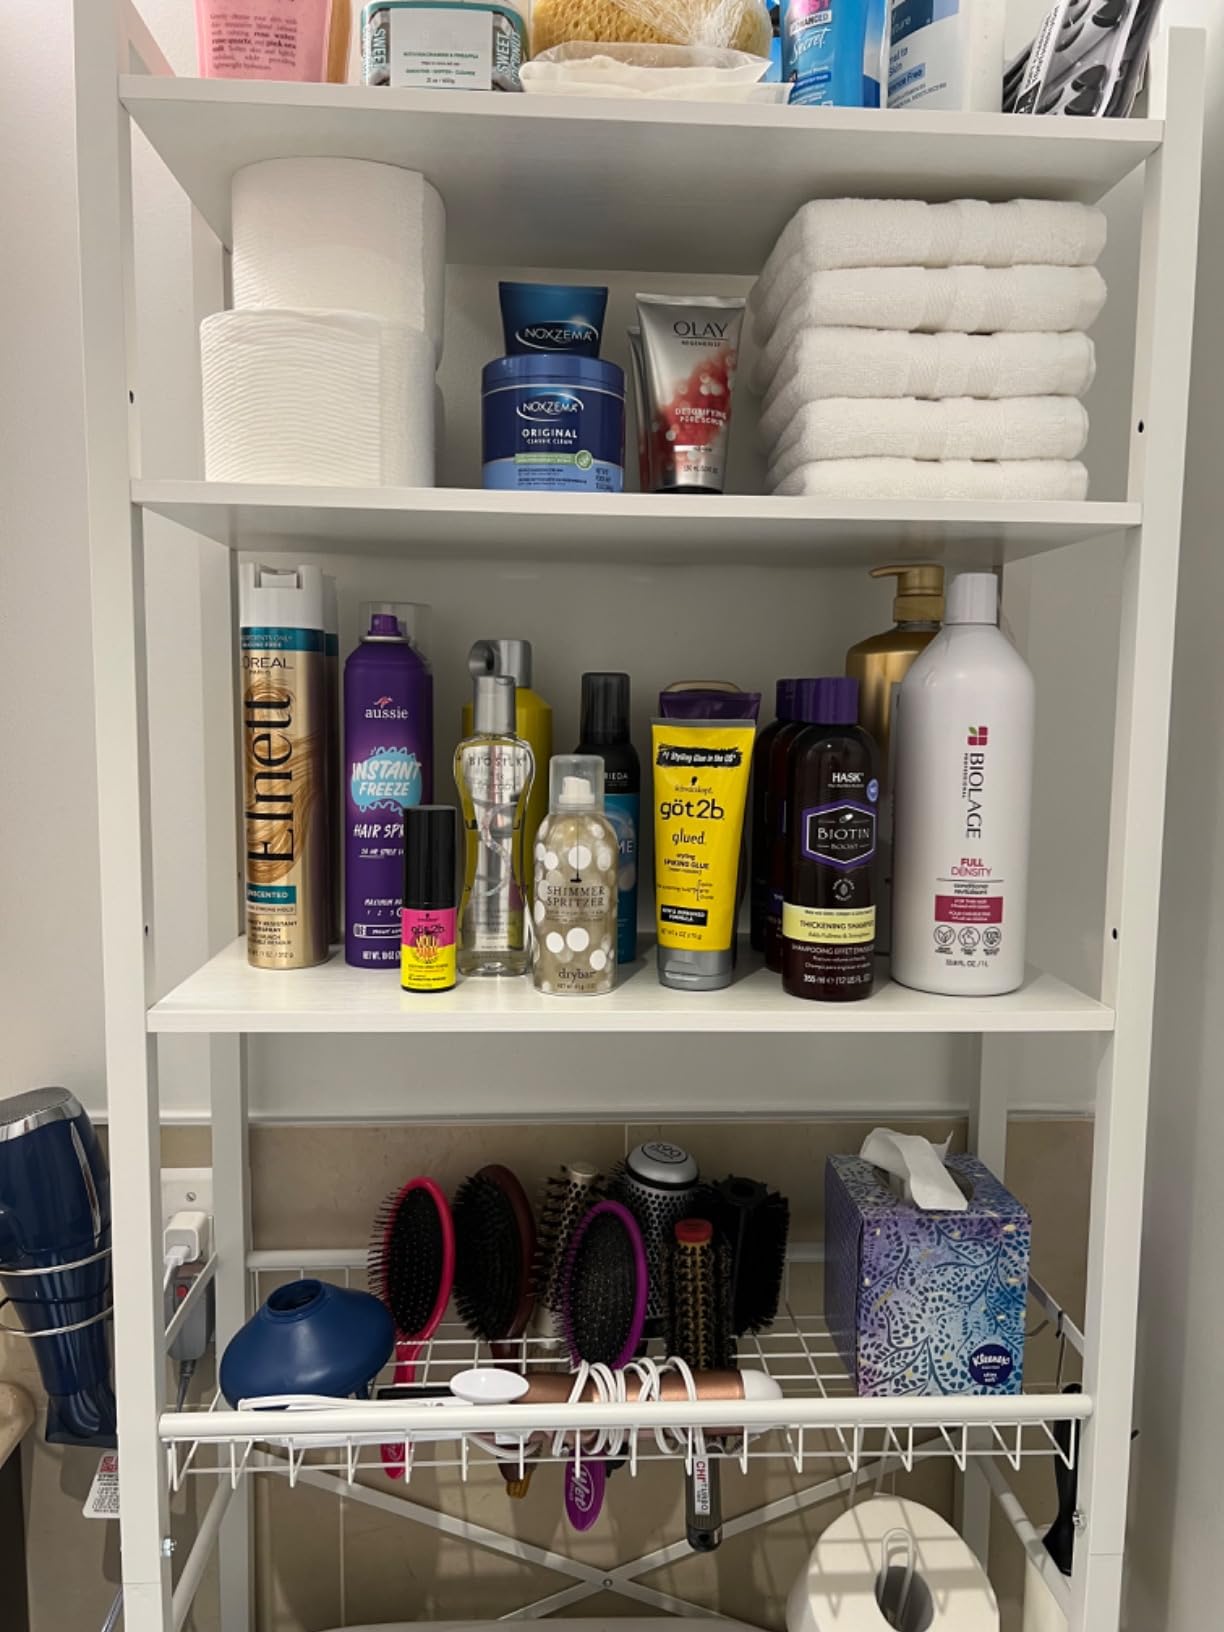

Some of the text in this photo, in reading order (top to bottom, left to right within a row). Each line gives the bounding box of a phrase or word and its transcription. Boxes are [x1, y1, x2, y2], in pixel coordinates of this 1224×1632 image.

[496, 32, 512, 73] SWEET
[789, 27, 832, 65] Secret
[524, 327, 593, 342] NOXZEMA
[673, 320, 729, 338] OLAY
[522, 400, 579, 414] NOXZEMA
[521, 428, 578, 439] ORIGINAL
[365, 706, 409, 719] aussie
[244, 694, 294, 861] Elnett
[352, 761, 422, 781] INSTANT
[604, 771, 629, 780] RIEDA
[832, 772, 863, 783] HASK
[359, 782, 410, 796] FREEZE
[966, 752, 985, 839] BIOLAGE
[660, 799, 725, 820] göt2b
[353, 824, 382, 839] HAIR
[672, 828, 706, 846] glued
[817, 827, 870, 840] BIOTIN
[690, 861, 710, 870] GLUE
[960, 858, 984, 867] FULL
[950, 866, 992, 877] DENSITY
[546, 885, 605, 898] SHIMMER
[546, 897, 605, 908] SPRITZER
[800, 920, 847, 930] THICKENING
[558, 968, 596, 983] drybar
[972, 1353, 1011, 1367] Kleenex
[695, 1460, 706, 1481] CHI
